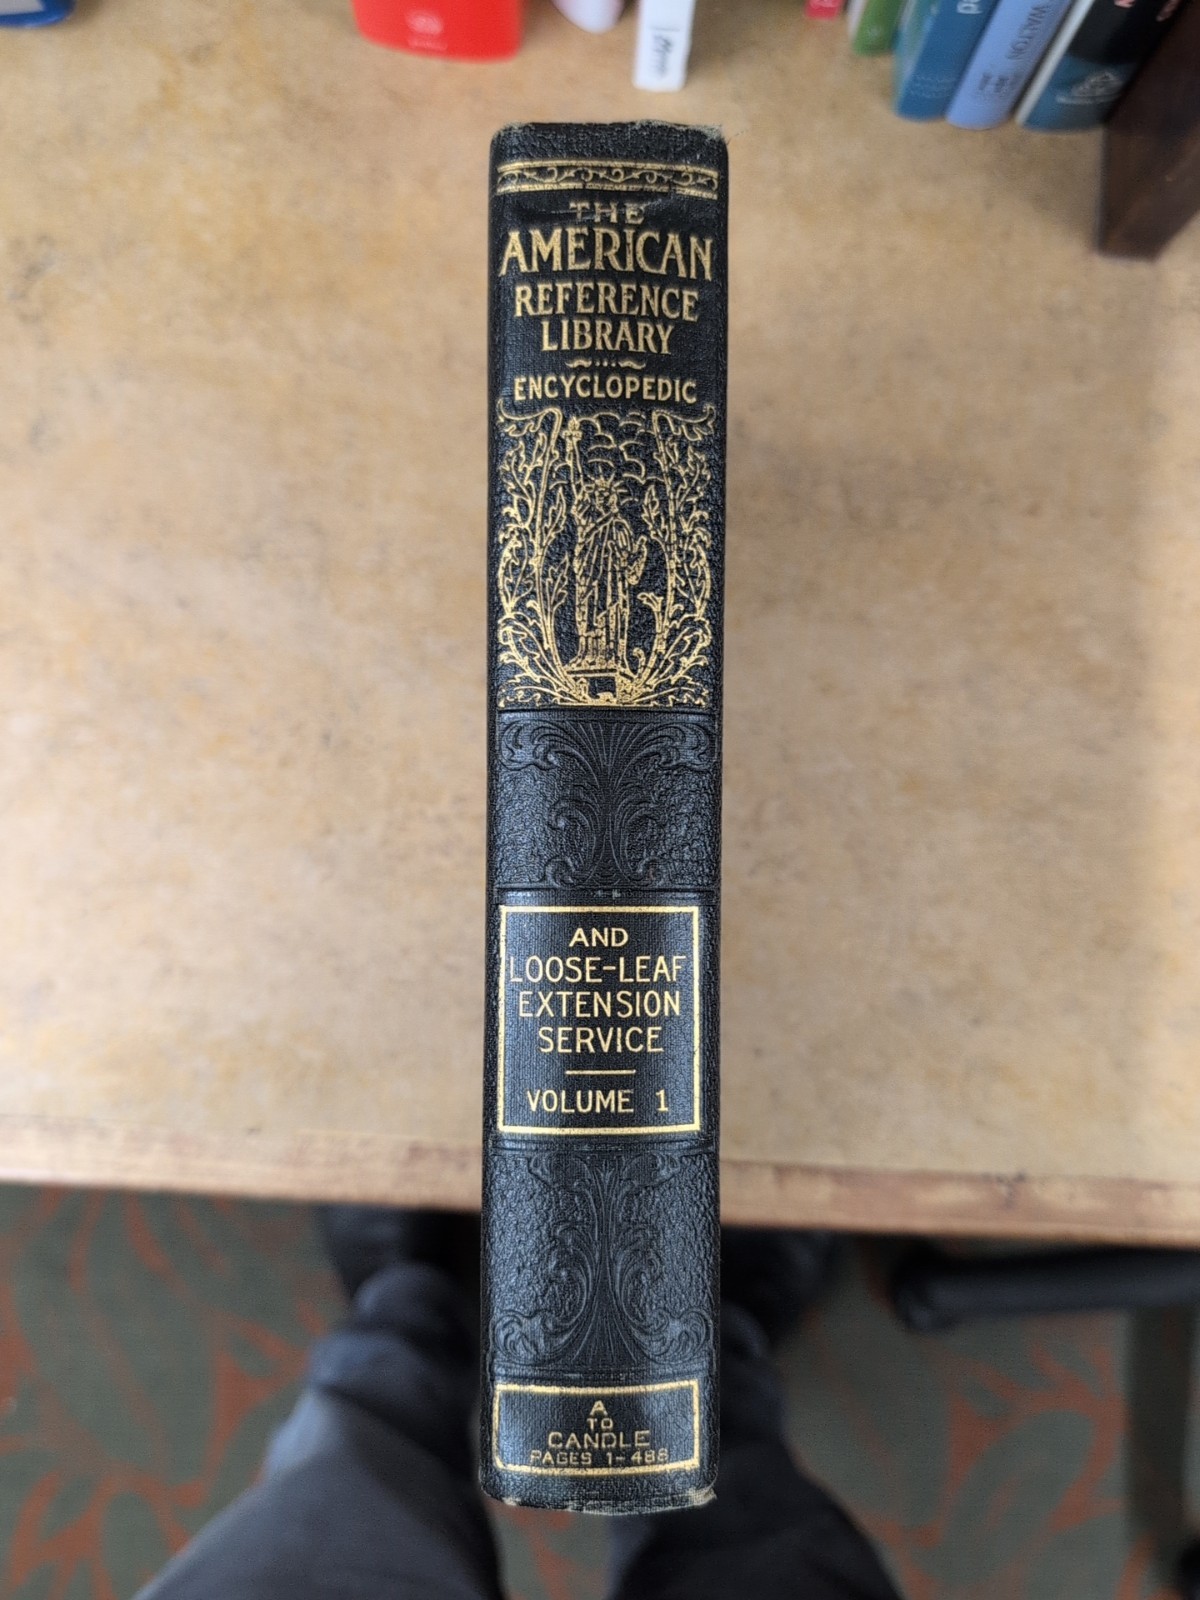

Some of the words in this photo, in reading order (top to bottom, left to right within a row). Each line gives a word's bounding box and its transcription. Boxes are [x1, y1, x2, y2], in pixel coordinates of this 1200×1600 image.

[568, 201, 645, 225] THE
[499, 227, 714, 281] AMERICAN
[514, 281, 699, 322] REFERENCE
[540, 319, 674, 355] LIBRARY
[514, 375, 697, 404] ENCYCLOPEDIC
[568, 927, 629, 947] AND
[509, 955, 687, 983] LOOSE-LEAF
[518, 990, 681, 1018] EXTENSION
[538, 1026, 665, 1053] SERVICE
[526, 1089, 634, 1113] VOLUME
[655, 1089, 669, 1112] 1
[589, 1400, 608, 1416] A
[586, 1418, 614, 1430] TO
[548, 1430, 651, 1449] CANDLE
[529, 1449, 593, 1466] PAGES
